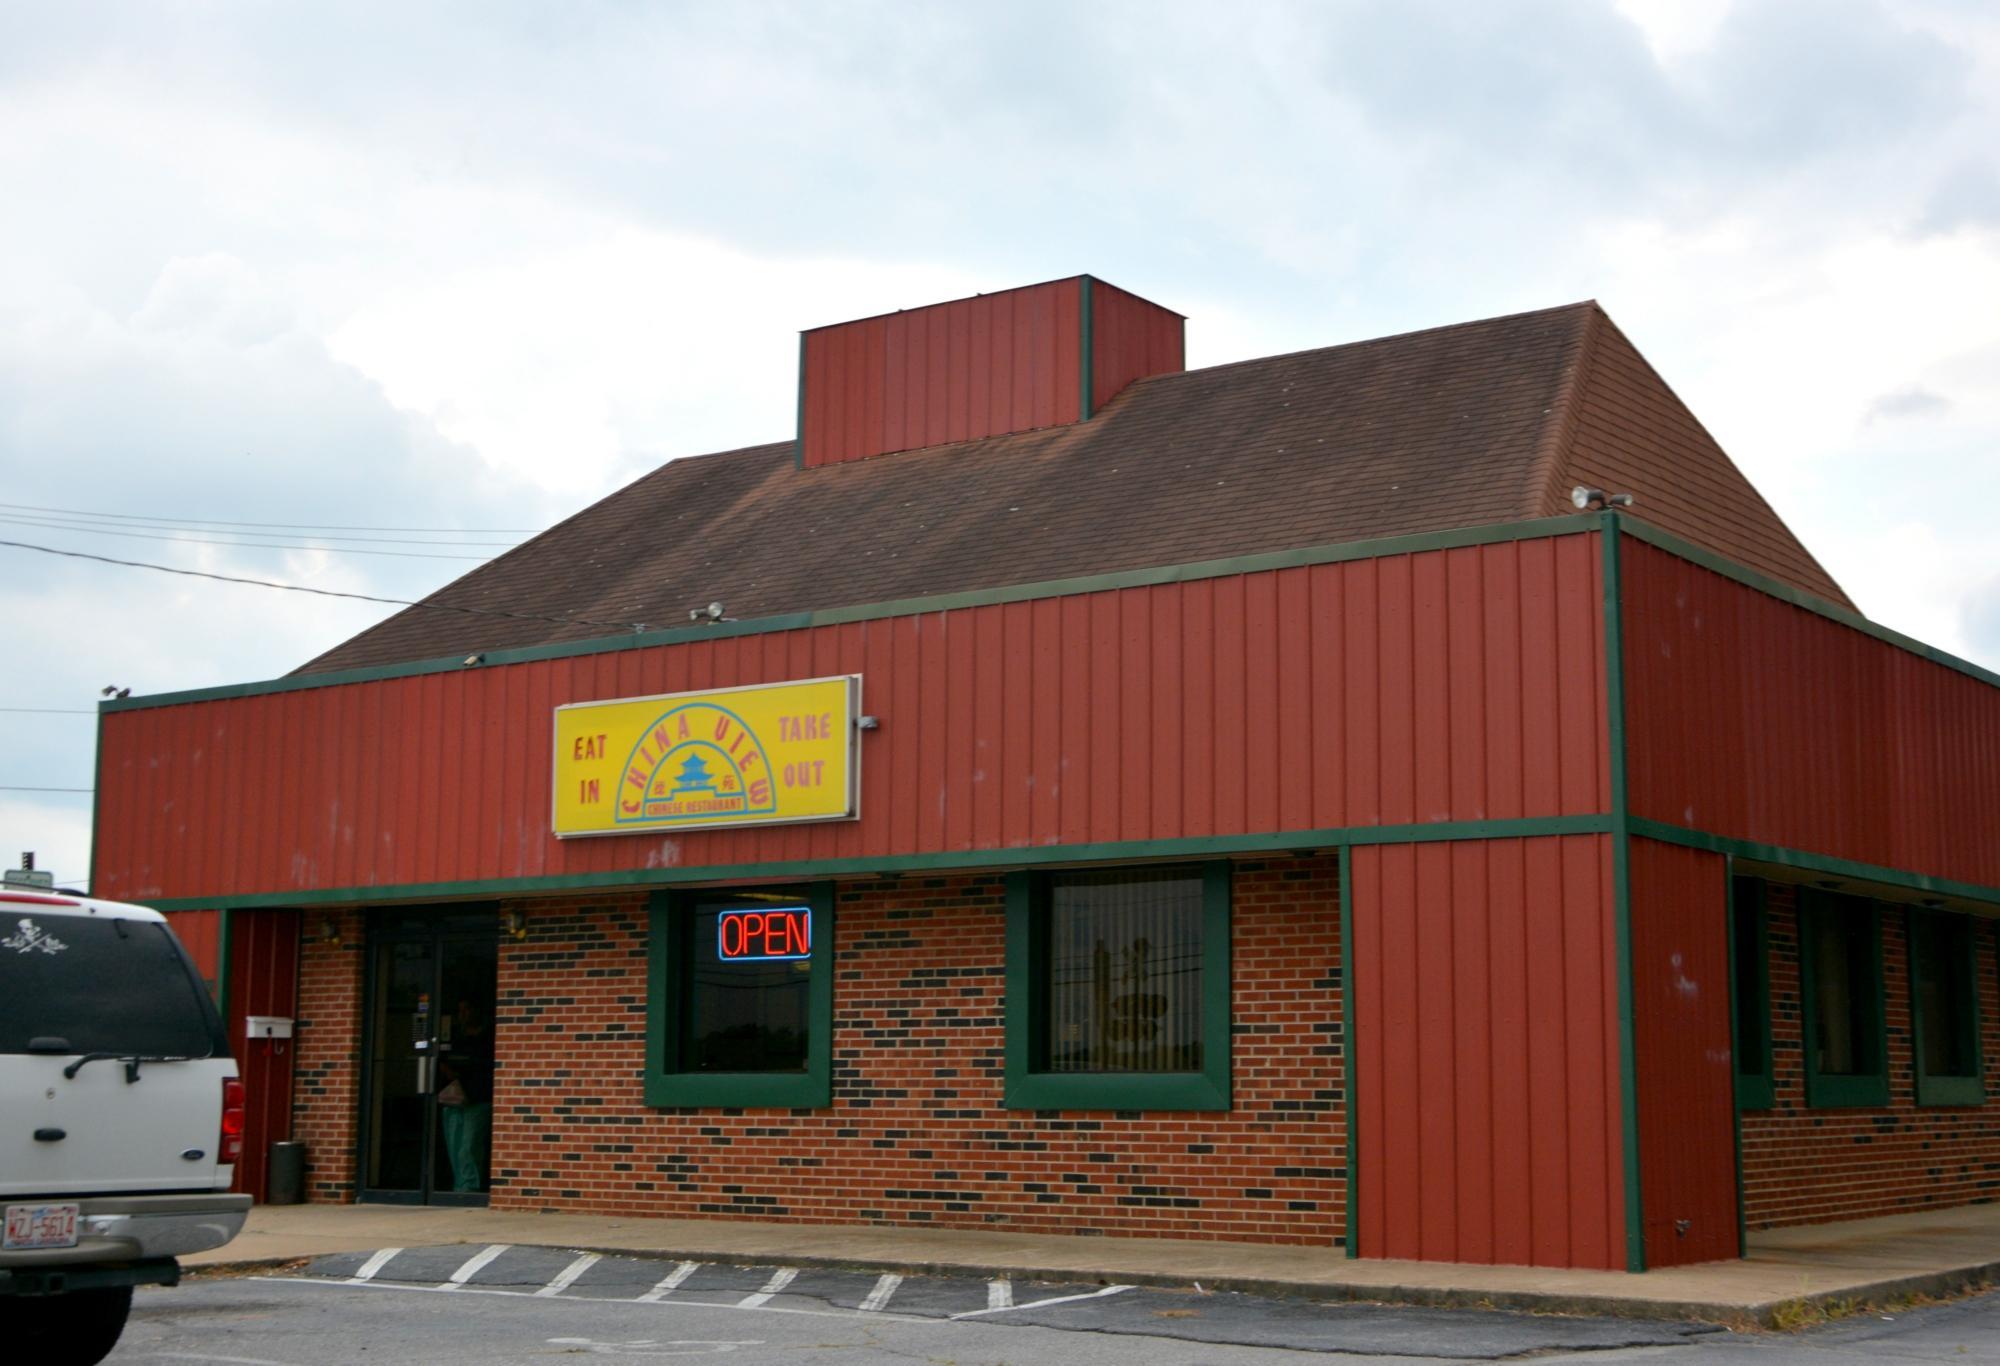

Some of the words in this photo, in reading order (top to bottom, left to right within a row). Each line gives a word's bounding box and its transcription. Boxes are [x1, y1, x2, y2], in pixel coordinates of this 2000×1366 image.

[778, 711, 832, 743] TAKE
[574, 734, 607, 761] EAT
[621, 713, 690, 814] CHINA
[783, 760, 825, 789] OUT
[580, 779, 600, 805] IN
[721, 913, 808, 956] OPEN
